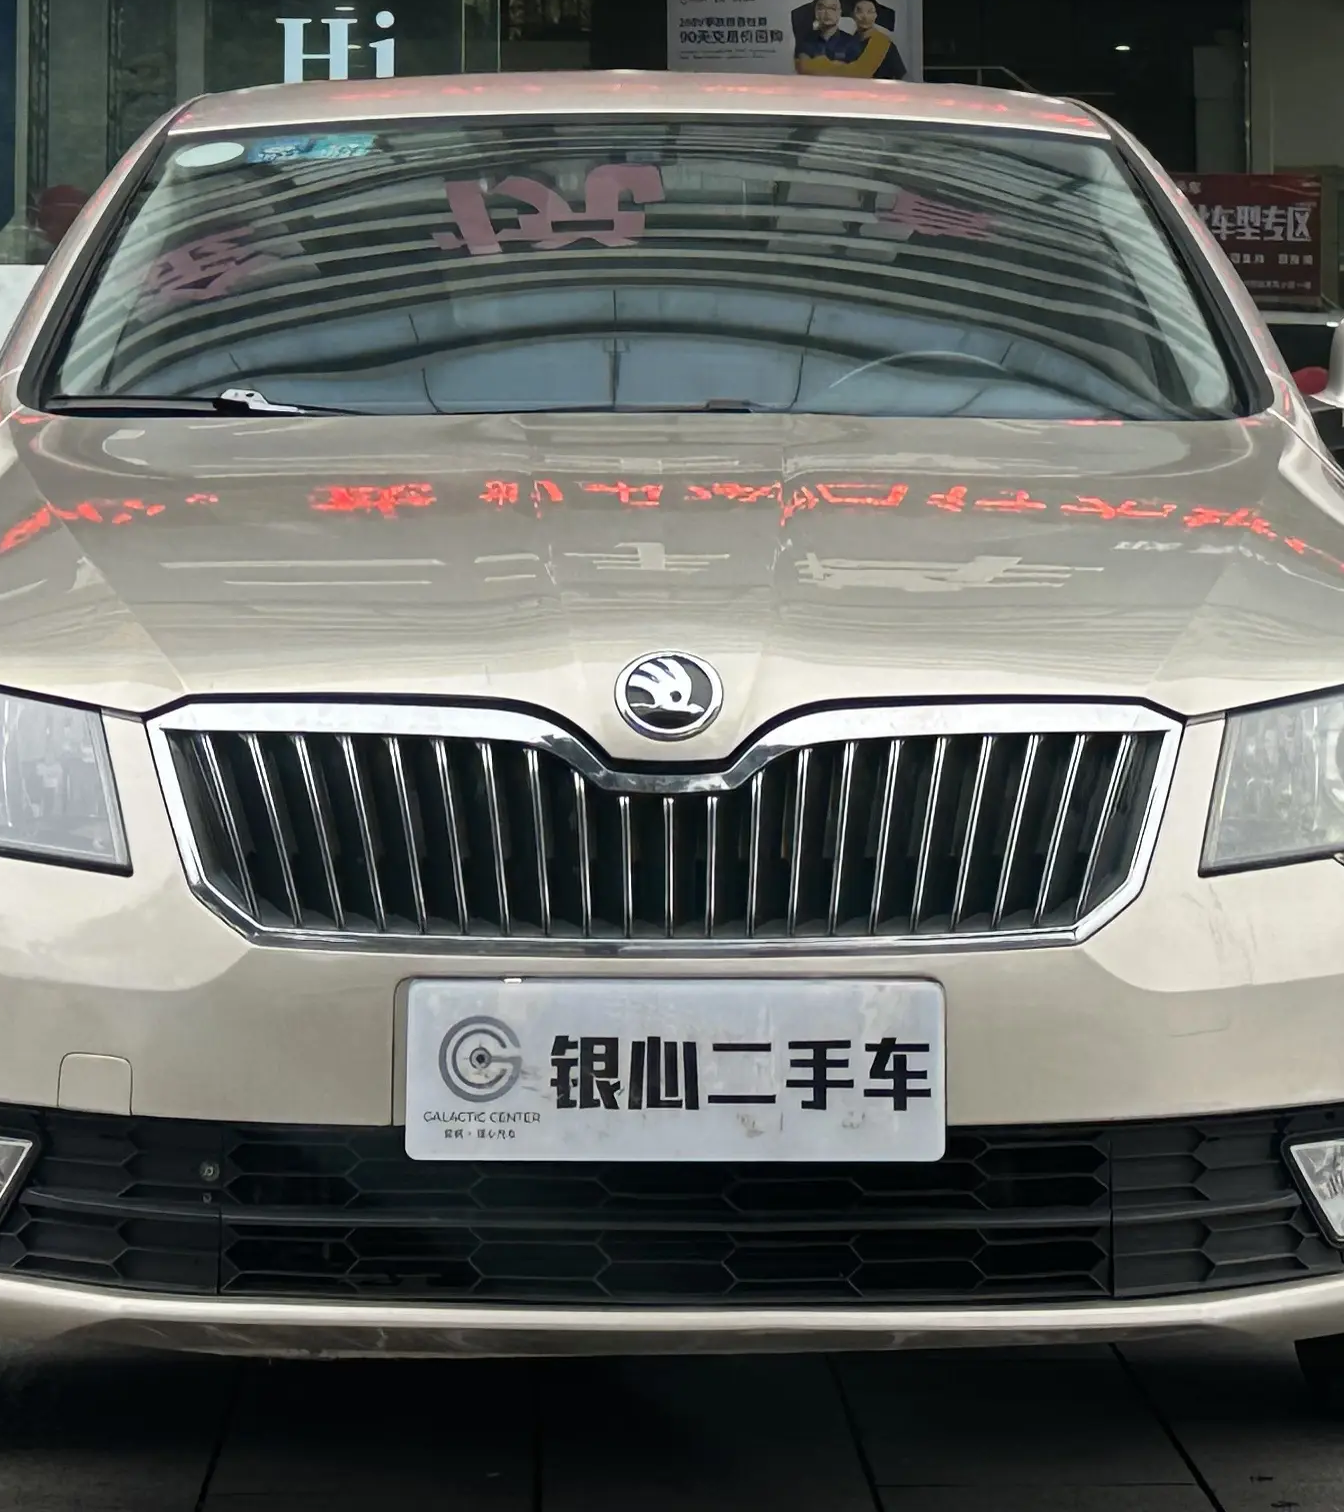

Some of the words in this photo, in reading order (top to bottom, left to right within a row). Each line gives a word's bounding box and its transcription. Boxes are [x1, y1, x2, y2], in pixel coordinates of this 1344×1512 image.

[274, 10, 396, 84] Hi
[550, 1035, 932, 1111] 银心二手车
[423, 1110, 486, 1123] GALACTIC
[489, 1111, 541, 1123] CENTER
